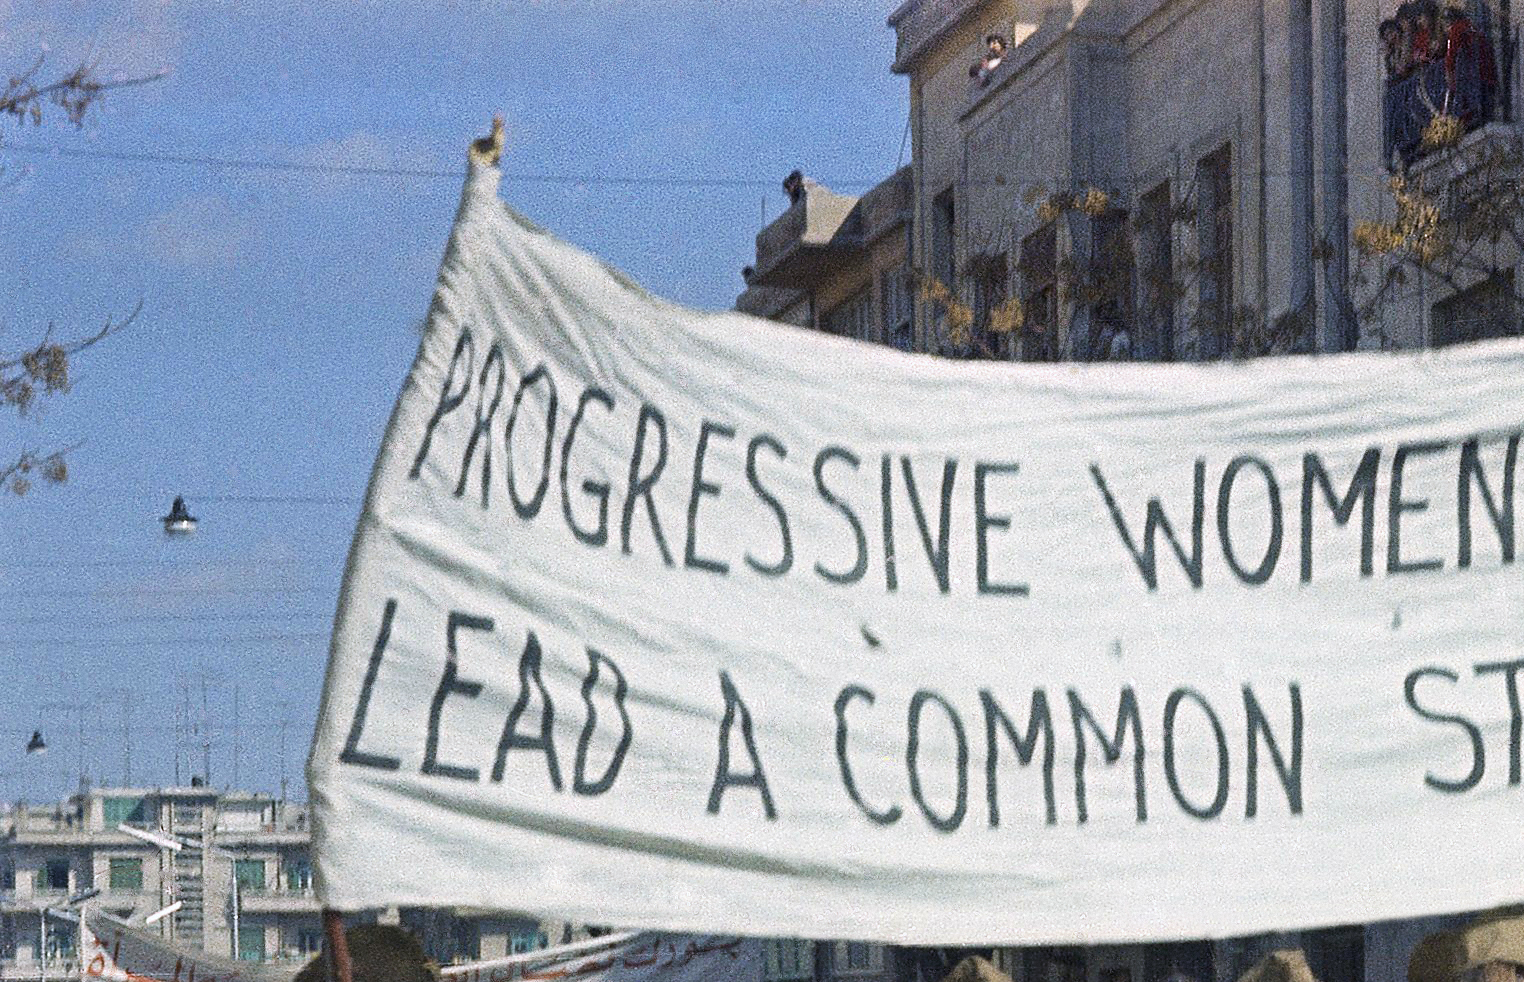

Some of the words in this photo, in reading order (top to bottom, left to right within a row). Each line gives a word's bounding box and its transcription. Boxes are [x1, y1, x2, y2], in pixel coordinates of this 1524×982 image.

[409, 324, 1030, 597] PROGRESSIVE
[1088, 429, 1521, 590] WOMEN
[340, 598, 634, 797] LEAD
[706, 669, 779, 822] A
[833, 681, 1305, 834] COMMON
